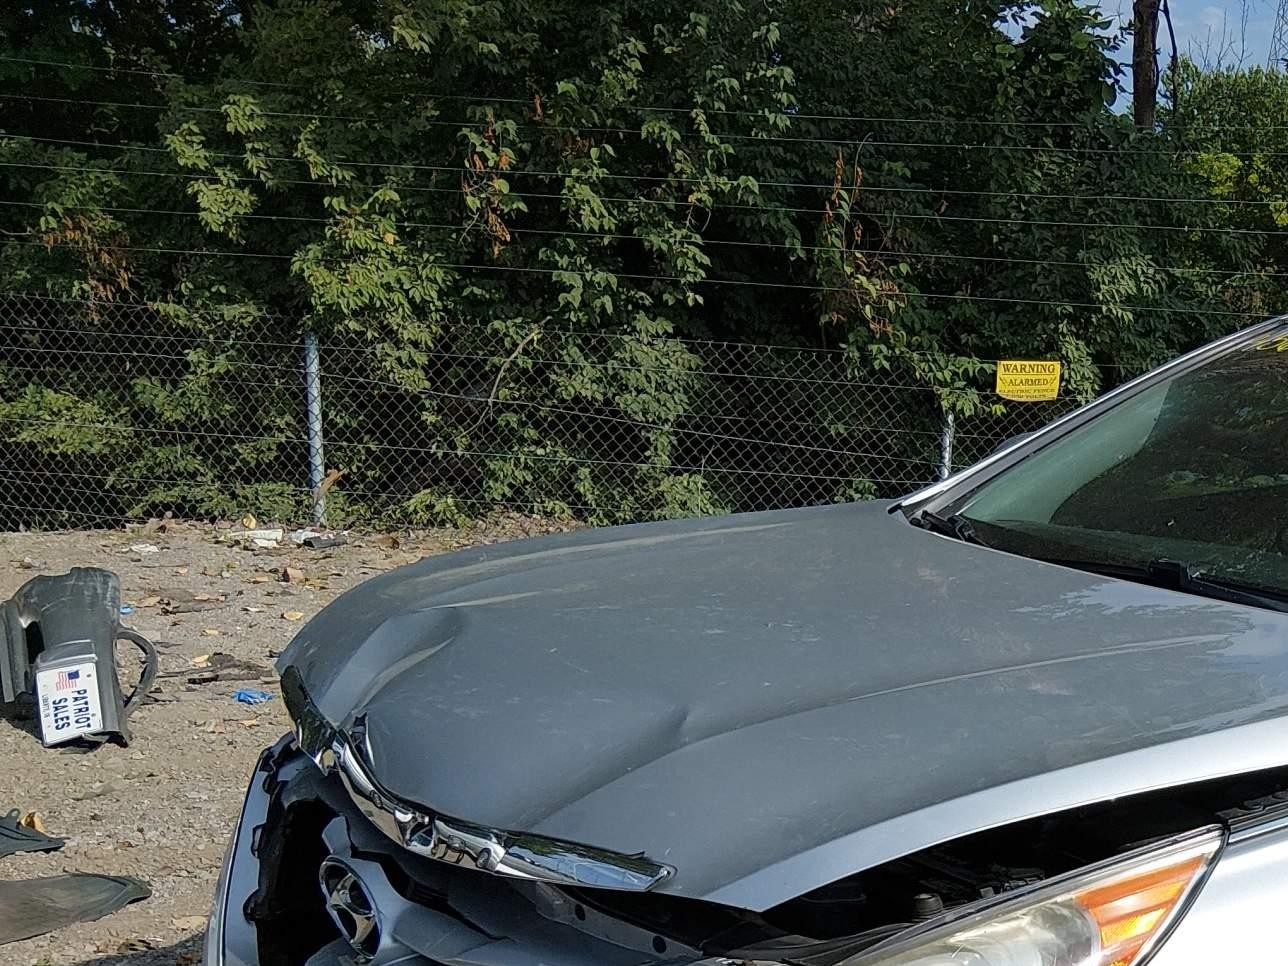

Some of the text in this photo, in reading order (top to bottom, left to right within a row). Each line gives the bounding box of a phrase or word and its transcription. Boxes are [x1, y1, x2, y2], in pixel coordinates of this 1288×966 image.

[1002, 363, 1056, 374] WARNING
[1008, 377, 1049, 387] ALARMED
[52, 697, 71, 730] SALES
[72, 689, 91, 730] PATRIOT
